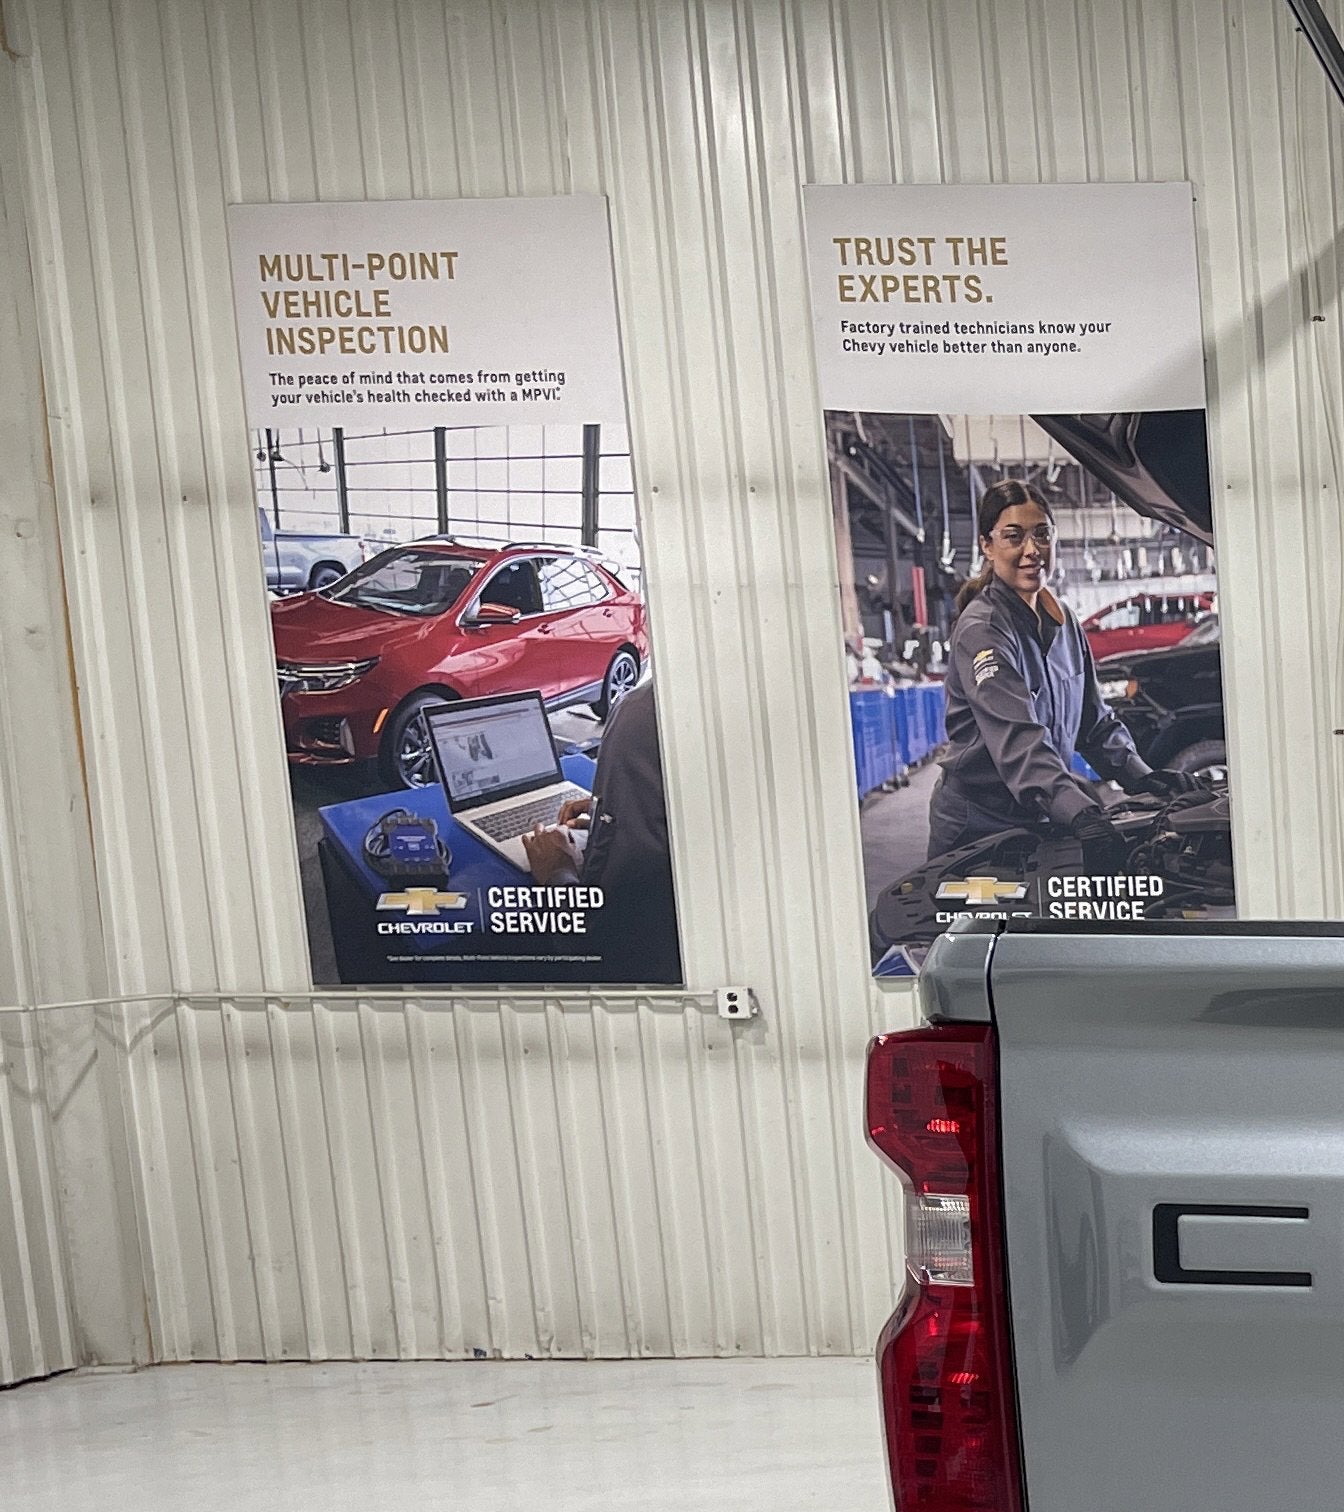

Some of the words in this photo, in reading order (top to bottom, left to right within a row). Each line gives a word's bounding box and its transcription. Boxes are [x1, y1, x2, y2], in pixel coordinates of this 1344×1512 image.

[833, 237, 936, 266] TRUST
[946, 237, 1008, 266] THE
[259, 252, 459, 282] MULTI-POINT
[838, 275, 993, 303] EXPERTS.
[261, 290, 391, 318] VEHICLE
[841, 320, 895, 337] Factory
[899, 321, 950, 334] trained
[954, 321, 1034, 334] technicians
[1038, 320, 1075, 334] know
[1079, 322, 1111, 336] your
[266, 326, 449, 354] INSPECTION
[842, 339, 885, 355] Chevy
[889, 340, 939, 353] vehicle
[943, 340, 987, 353] better
[991, 340, 1022, 353] than
[1027, 342, 1081, 355] anyone.
[269, 372, 294, 386] The
[298, 374, 338, 389] peace
[342, 371, 355, 385] of
[359, 371, 393, 385] mind
[396, 371, 426, 384] that
[429, 373, 474, 384] comes
[477, 370, 511, 383] from
[515, 369, 565, 386] getting
[272, 393, 301, 408] your
[305, 389, 364, 403] vehicle's
[367, 389, 411, 403] health
[414, 389, 472, 402] checked
[475, 389, 506, 402] with
[510, 391, 518, 402] a
[488, 887, 604, 908] CERTIFIED
[1048, 876, 1164, 898] CERTIFIED
[1049, 901, 1145, 920] SERVICE
[377, 922, 474, 934] CHEVROLET
[491, 912, 587, 933] SERVICE
